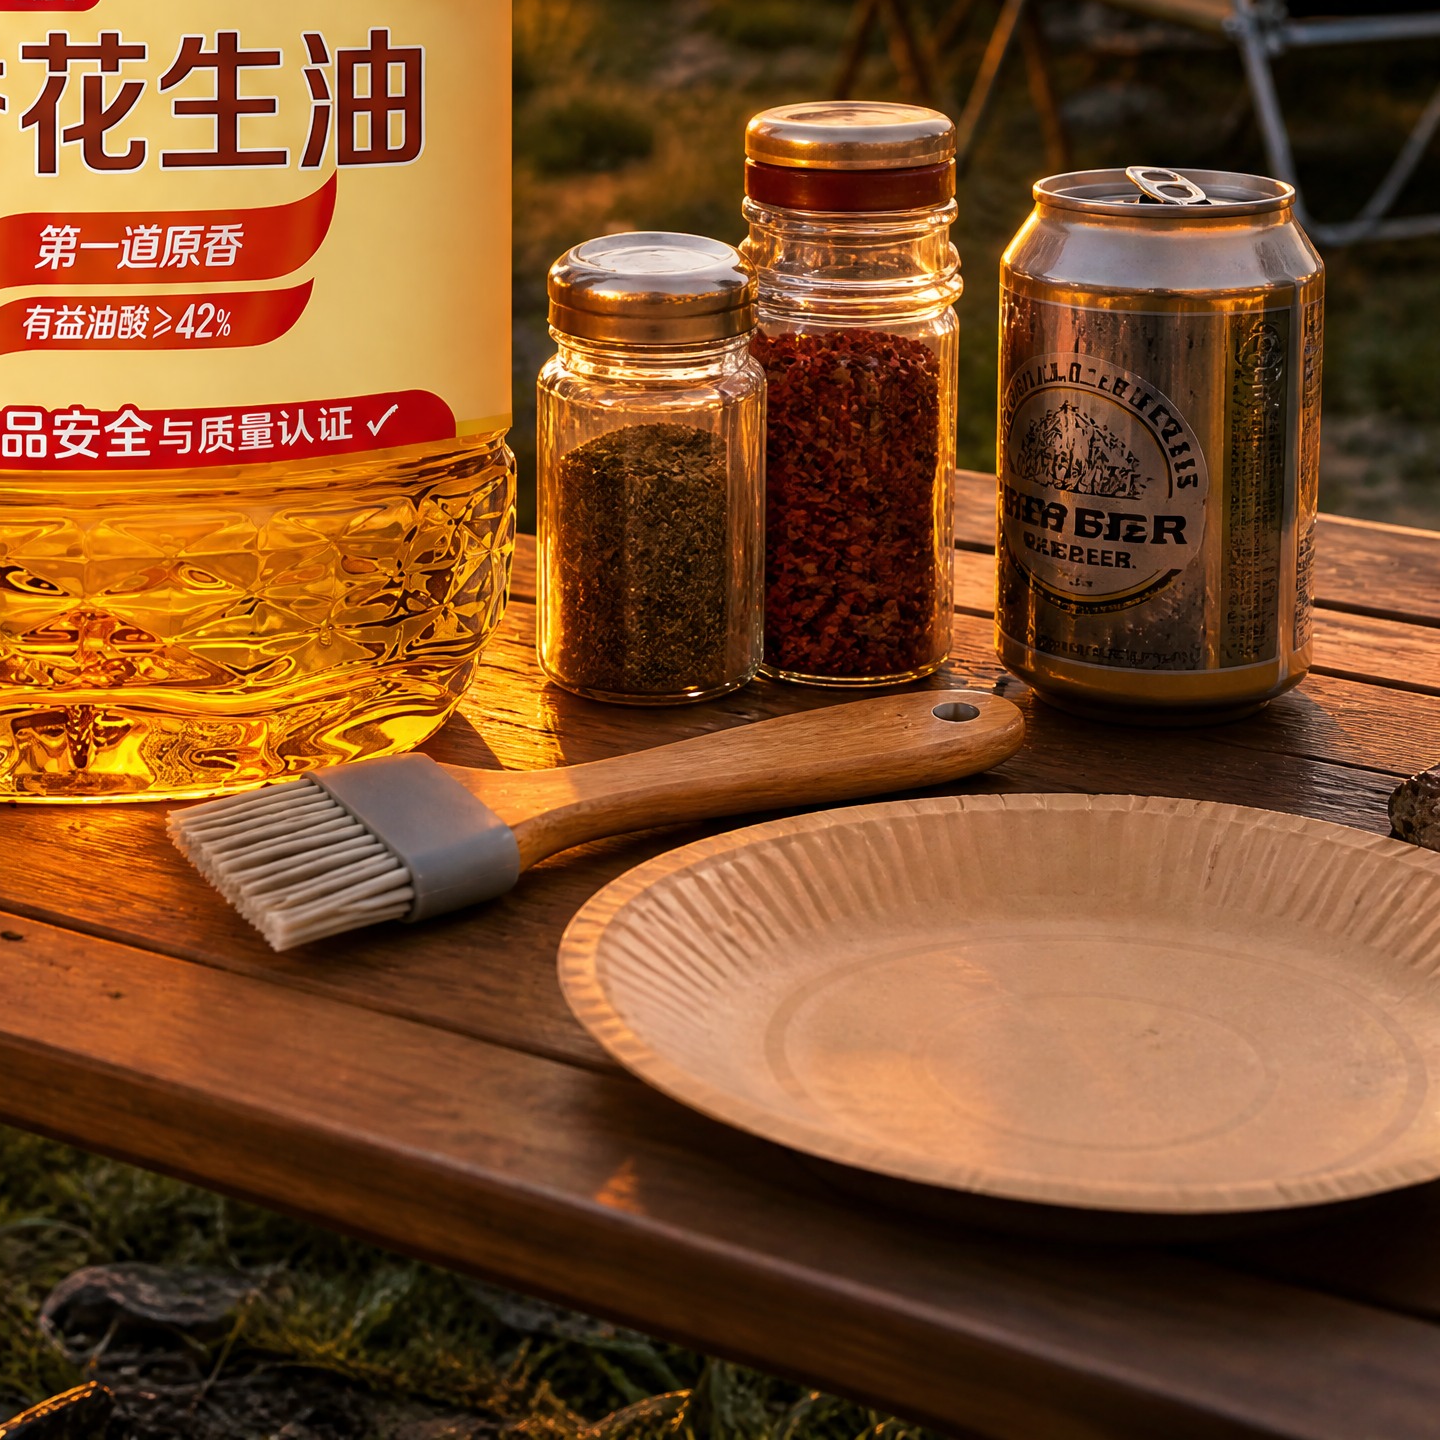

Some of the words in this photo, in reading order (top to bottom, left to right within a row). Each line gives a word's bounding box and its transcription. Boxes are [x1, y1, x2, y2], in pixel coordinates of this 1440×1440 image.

[34, 223, 245, 270] 第一道原香
